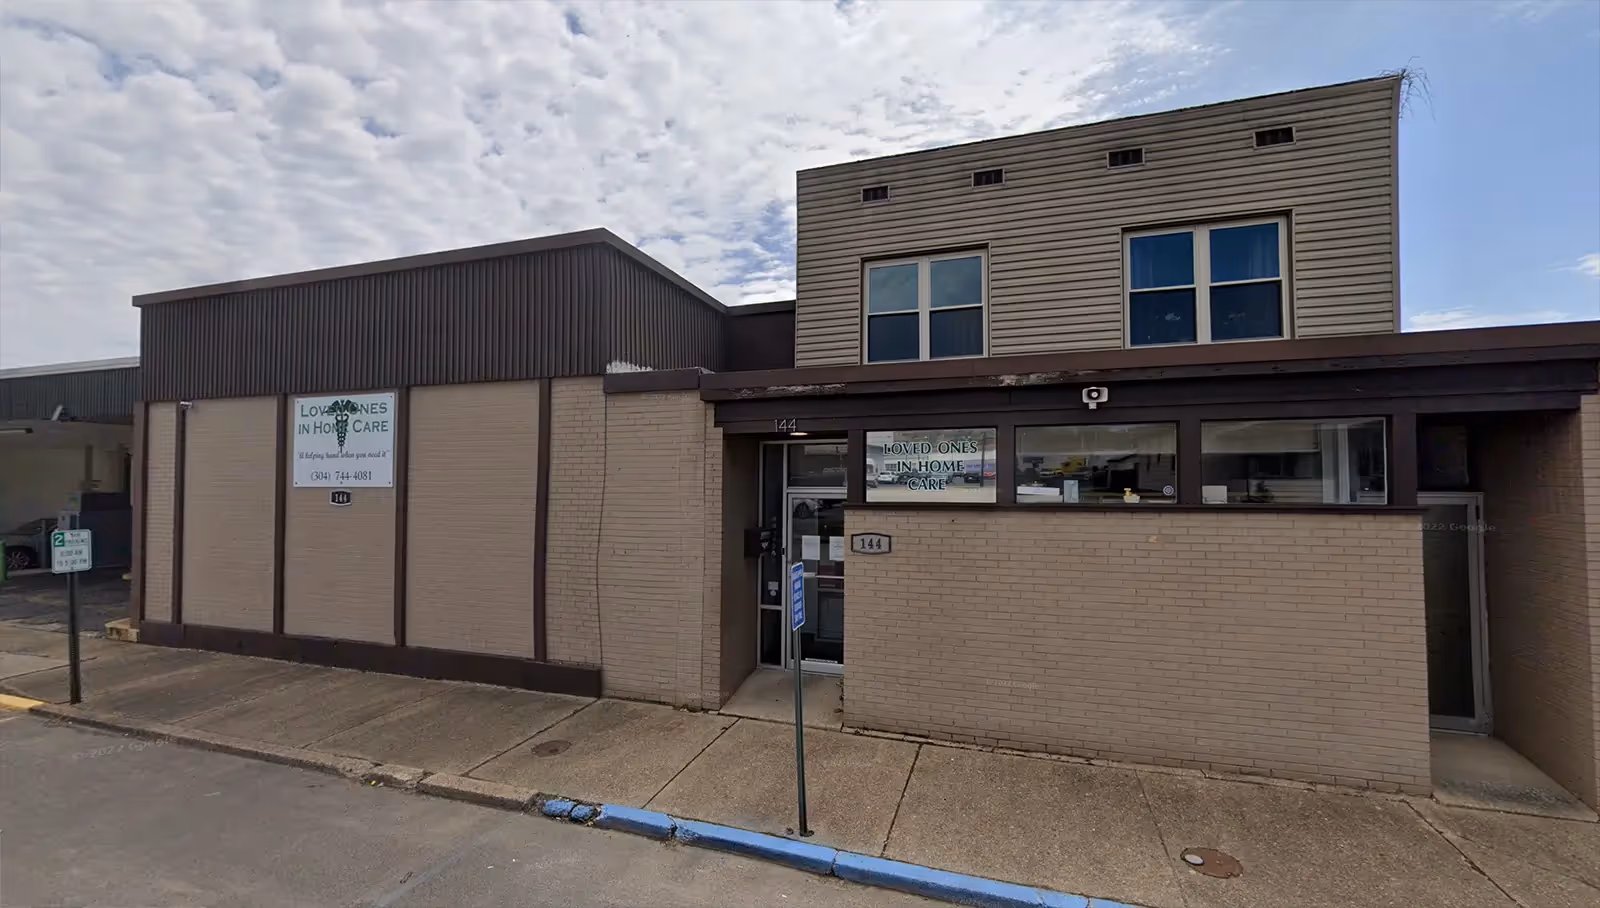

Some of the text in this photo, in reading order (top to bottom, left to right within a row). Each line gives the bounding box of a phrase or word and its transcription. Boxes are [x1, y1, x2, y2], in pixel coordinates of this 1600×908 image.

[348, 402, 388, 415] ONES
[298, 423, 310, 435] IN
[352, 419, 389, 433] CARE
[774, 418, 796, 432] 144
[884, 440, 978, 455] LOVED ONES
[897, 460, 965, 473] IN HOME
[310, 469, 372, 481] (304) 744-4081
[907, 477, 946, 491] CARE
[54, 534, 63, 545] 2
[860, 538, 882, 550] 144
